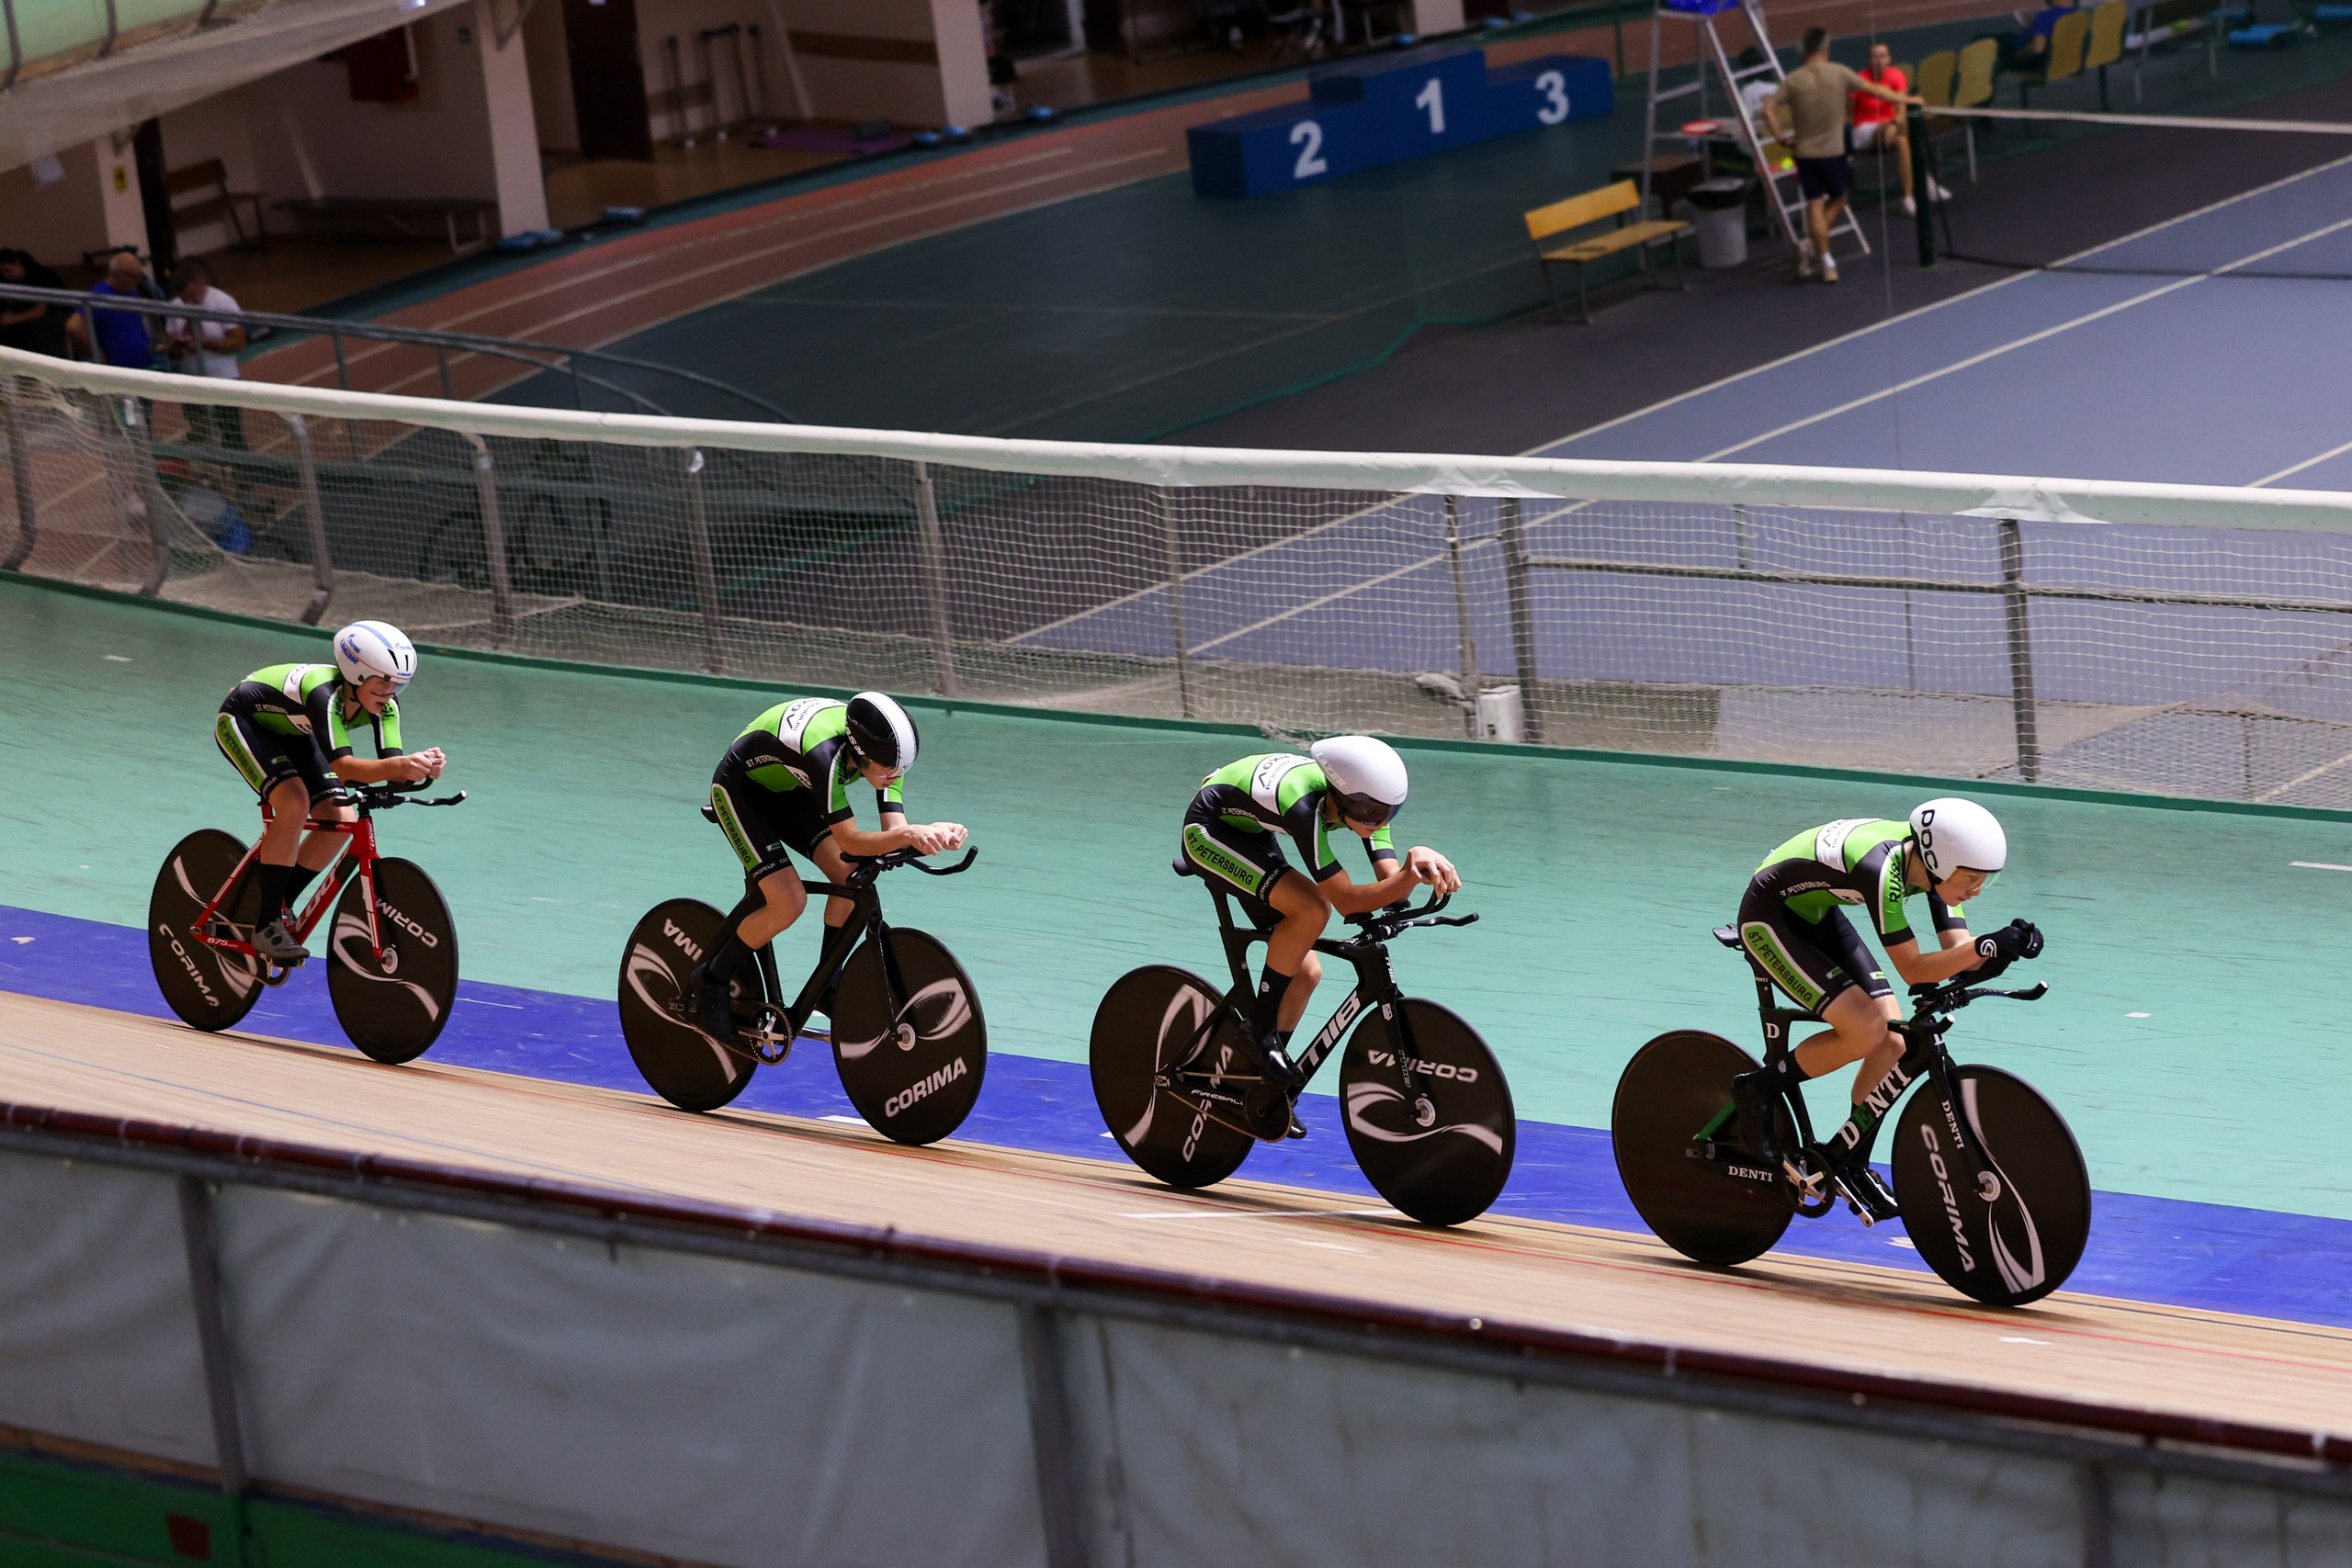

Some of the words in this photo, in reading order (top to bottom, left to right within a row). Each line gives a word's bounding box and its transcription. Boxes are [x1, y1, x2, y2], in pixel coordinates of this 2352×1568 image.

[1415, 79, 1445, 134] 1
[1535, 71, 1570, 125] 3
[1290, 121, 1327, 179] 2
[223, 732, 259, 784] PETERSBURG
[1315, 751, 1347, 788] LAZER
[719, 806, 752, 864] PETERSBURG
[1187, 832, 1198, 848] ST.
[1194, 846, 1254, 886] PETERSBURG
[1921, 809, 1939, 871] POC
[375, 895, 438, 949] CORIM
[158, 923, 220, 1008] CORIMA
[1748, 931, 1764, 947] ST.
[1758, 941, 1813, 1002] PETERSBURG
[1765, 1022, 1781, 1039] D
[885, 1056, 967, 1118] CORIMA
[1182, 1043, 1234, 1163] CORMA
[1838, 1062, 1912, 1150] DENTI
[1941, 1100, 1965, 1150] DENTI
[1728, 1165, 1773, 1182] DENTI
[1920, 1123, 1975, 1272] CORIMA
